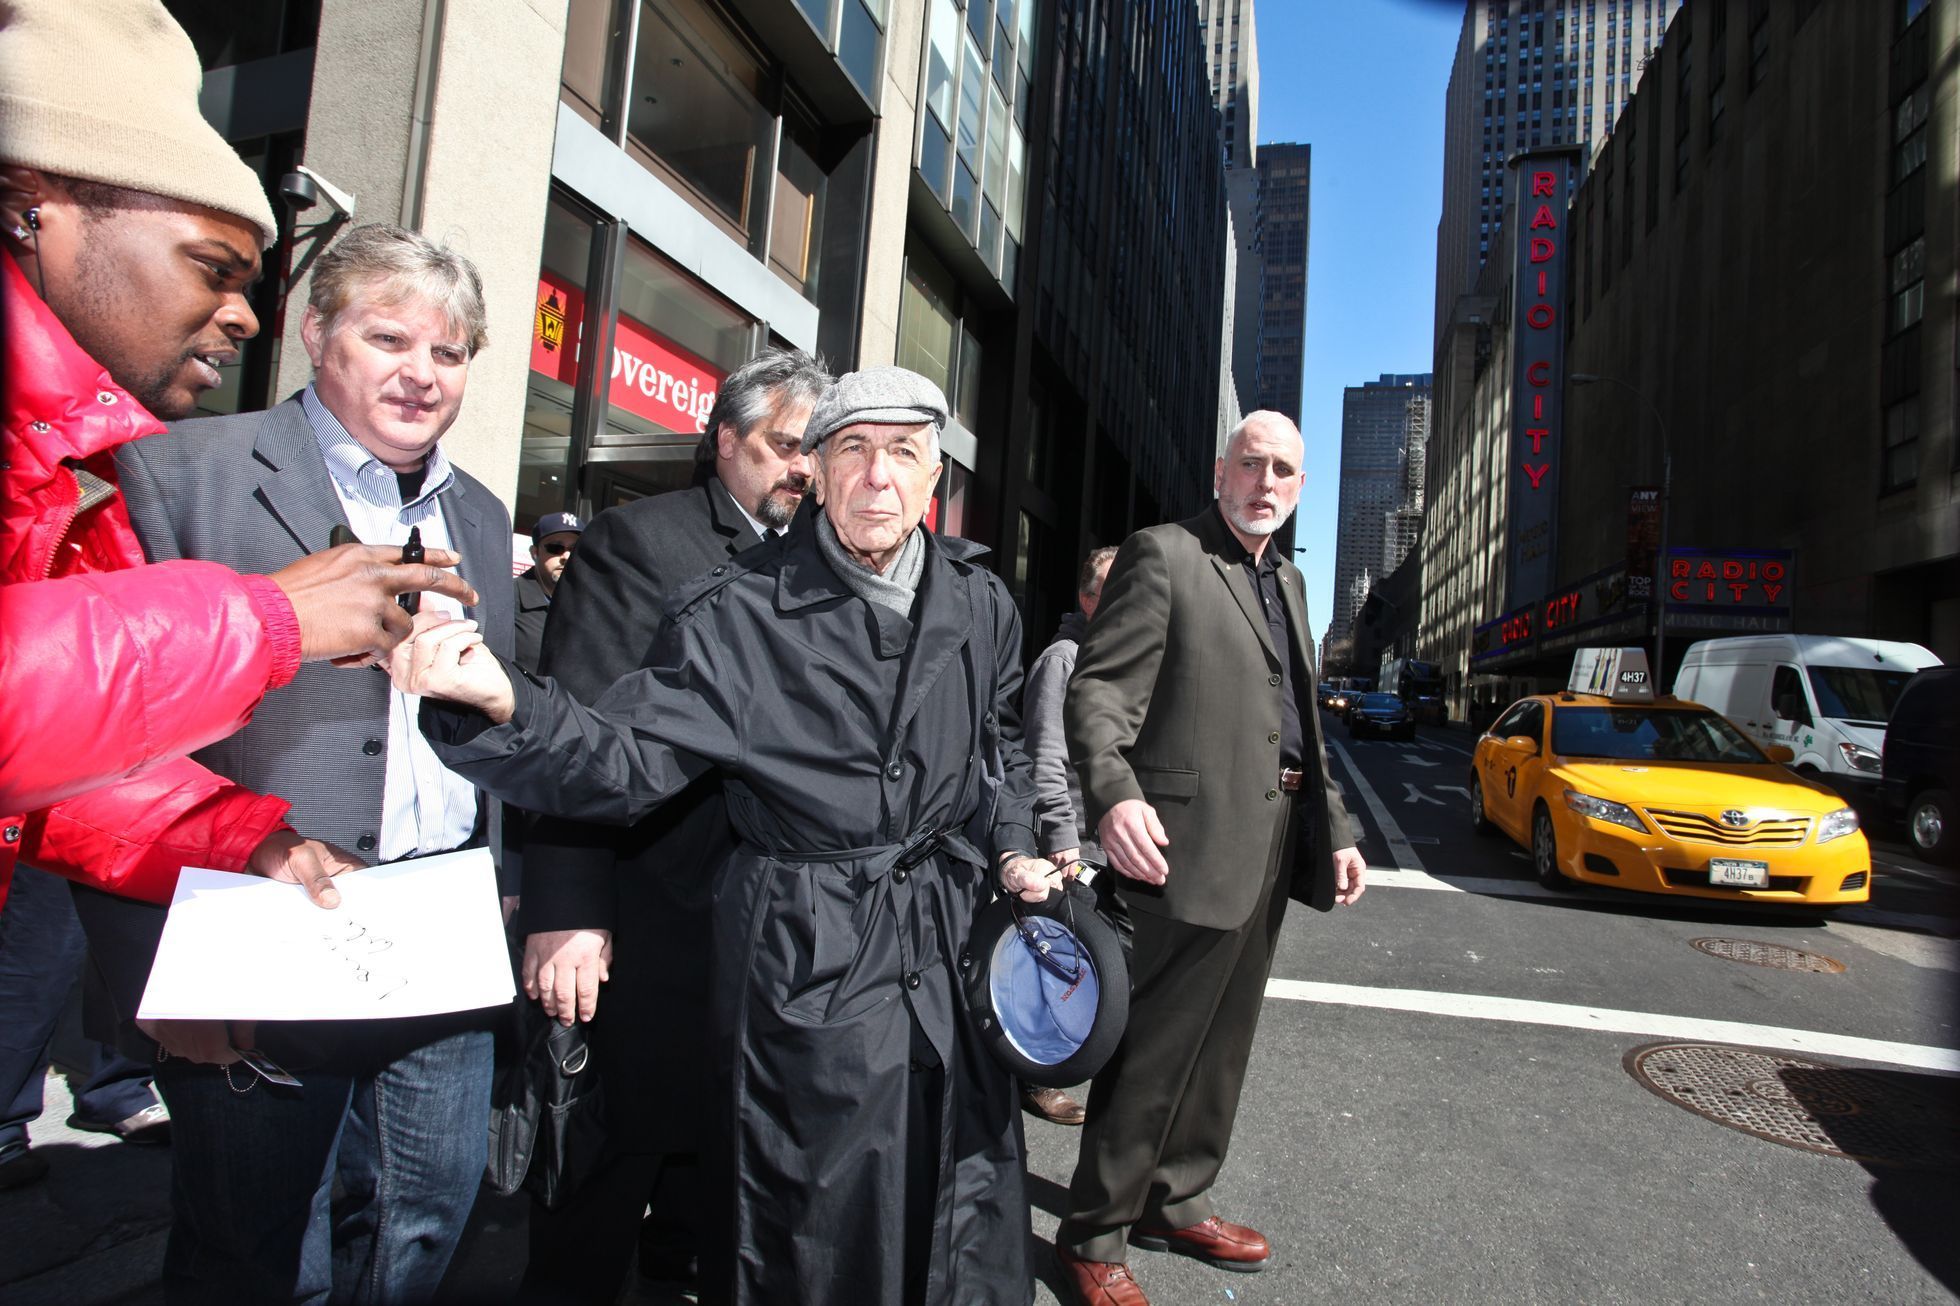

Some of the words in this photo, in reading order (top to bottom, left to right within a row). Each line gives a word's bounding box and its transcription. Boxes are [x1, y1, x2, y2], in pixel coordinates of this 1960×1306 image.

[1526, 171, 1557, 329] RADIO
[609, 345, 716, 433] overeig
[1523, 361, 1551, 489] CITY
[562, 512, 577, 527] NY
[1628, 576, 1651, 584] TOP
[1672, 559, 1785, 581] RADIO
[1671, 581, 1783, 603] CITY
[1546, 592, 1581, 628] CITY
[1664, 613, 1723, 628] MUSIC
[1735, 615, 1787, 631] HALL
[1621, 671, 1645, 682] 4H37
